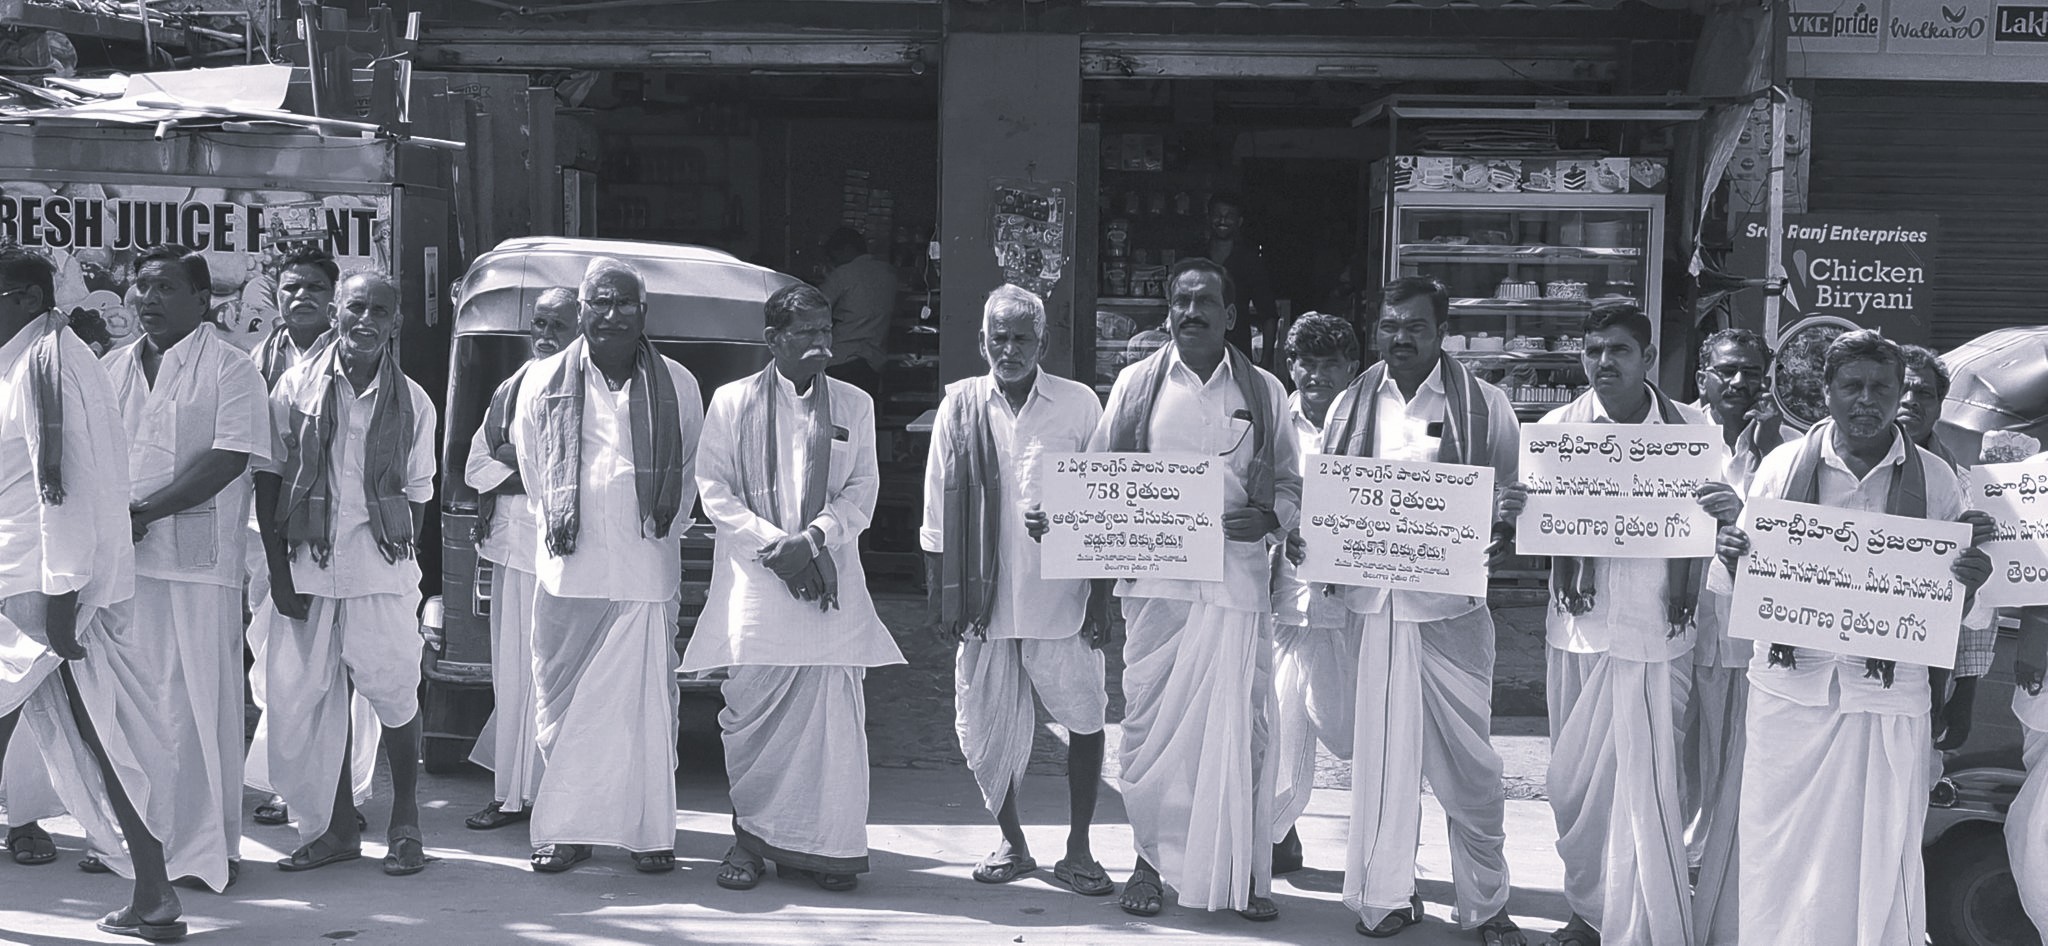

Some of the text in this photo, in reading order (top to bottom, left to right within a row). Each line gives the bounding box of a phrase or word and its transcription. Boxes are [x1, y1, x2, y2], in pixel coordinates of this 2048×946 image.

[1788, 12, 1878, 37] VKC pride
[113, 200, 236, 252] JUICE
[247, 204, 377, 257] PNT
[1787, 224, 1828, 243] Ranj
[1830, 226, 1928, 245] Enterprises
[1809, 258, 1925, 284] Chicken
[1816, 285, 1913, 315] Biryani
[1529, 433, 1710, 463] జూబ్లీహిల్స్ ప్రజలారా
[1057, 461, 1065, 473] 2
[1131, 460, 1164, 474] పాలన
[1168, 461, 1210, 475] కాలంలో
[1320, 462, 1328, 475] 2
[1396, 467, 1431, 483] పాలన
[1435, 471, 1479, 486] కాలంలో
[1086, 481, 1181, 507] 758 రైతులు
[1632, 473, 1655, 497] మీరు
[1349, 487, 1446, 516] 758 రైతులు
[1052, 509, 1129, 531] ఆత్మహత్యలు
[1311, 513, 1391, 538] ఆత్మహత్యలు
[1540, 512, 1692, 545] తెలంగాణ రైతుల గోస
[1755, 513, 1958, 556] జూబ్లీహిల్స్ ప్రజలారా
[1748, 550, 1777, 578] మేము
[1865, 566, 1890, 594] మీరు
[1758, 597, 1927, 642] తెలంగాణ రైతుల గోస
